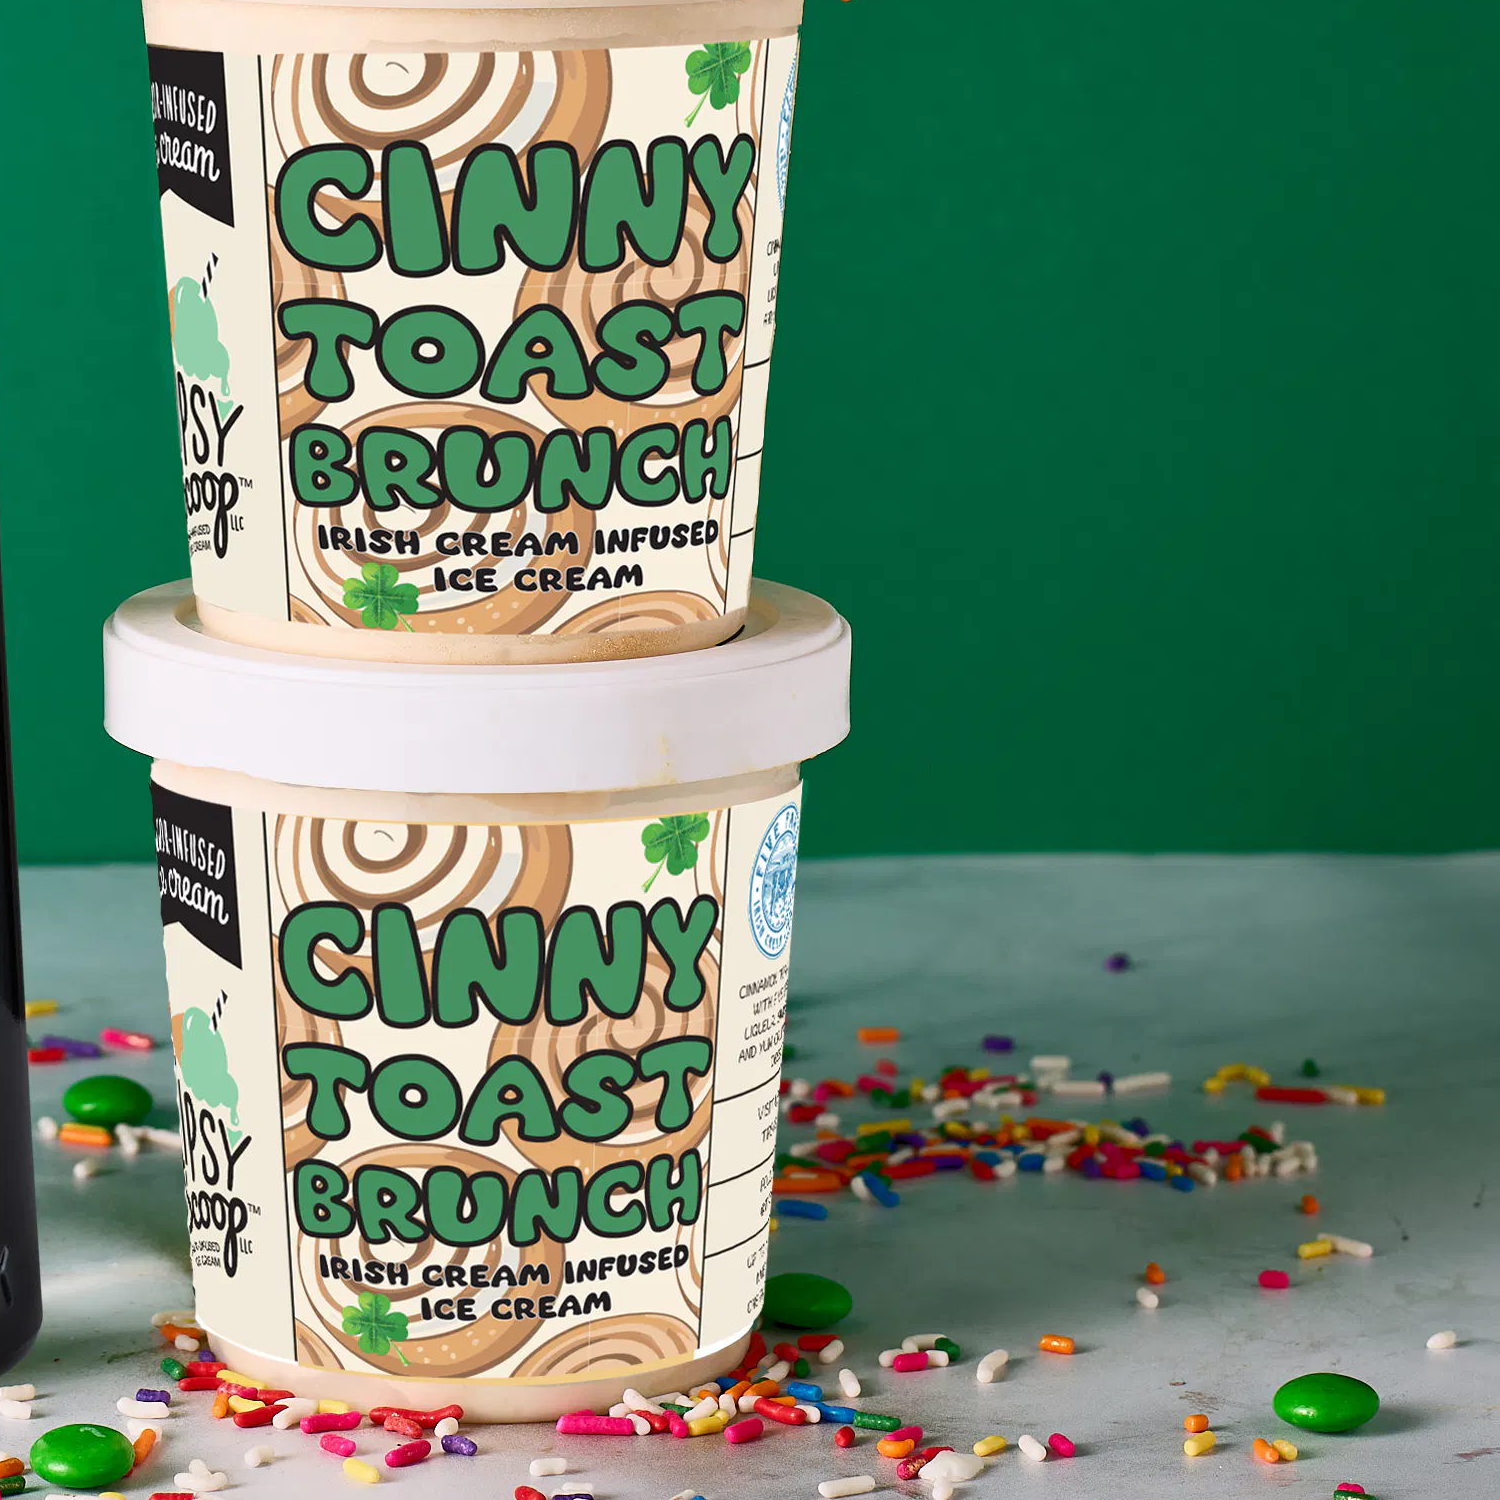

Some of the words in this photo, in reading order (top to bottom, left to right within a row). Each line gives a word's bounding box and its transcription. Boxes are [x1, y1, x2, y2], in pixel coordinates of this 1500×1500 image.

[159, 131, 221, 183] cream
[274, 133, 758, 278] CINNY
[277, 289, 746, 404] TOAST
[288, 414, 733, 514] BRUNCH
[230, 514, 245, 532] LLC
[316, 523, 421, 556] IRISH
[434, 529, 579, 558] CREAM
[593, 518, 720, 553] INFUSED
[432, 566, 499, 593] ICE
[512, 563, 644, 593] CREAM
[167, 867, 230, 926] cream
[278, 893, 720, 1029] CINNY
[281, 1035, 714, 1145] TOAST
[292, 1148, 702, 1247] BRUNCH
[239, 1236, 254, 1255] LLC
[319, 1252, 411, 1287] IRISH
[420, 1262, 551, 1288] CREAM
[563, 1244, 691, 1285] INFUSED
[420, 1295, 478, 1321] ICE
[489, 1290, 612, 1321] CREAM
